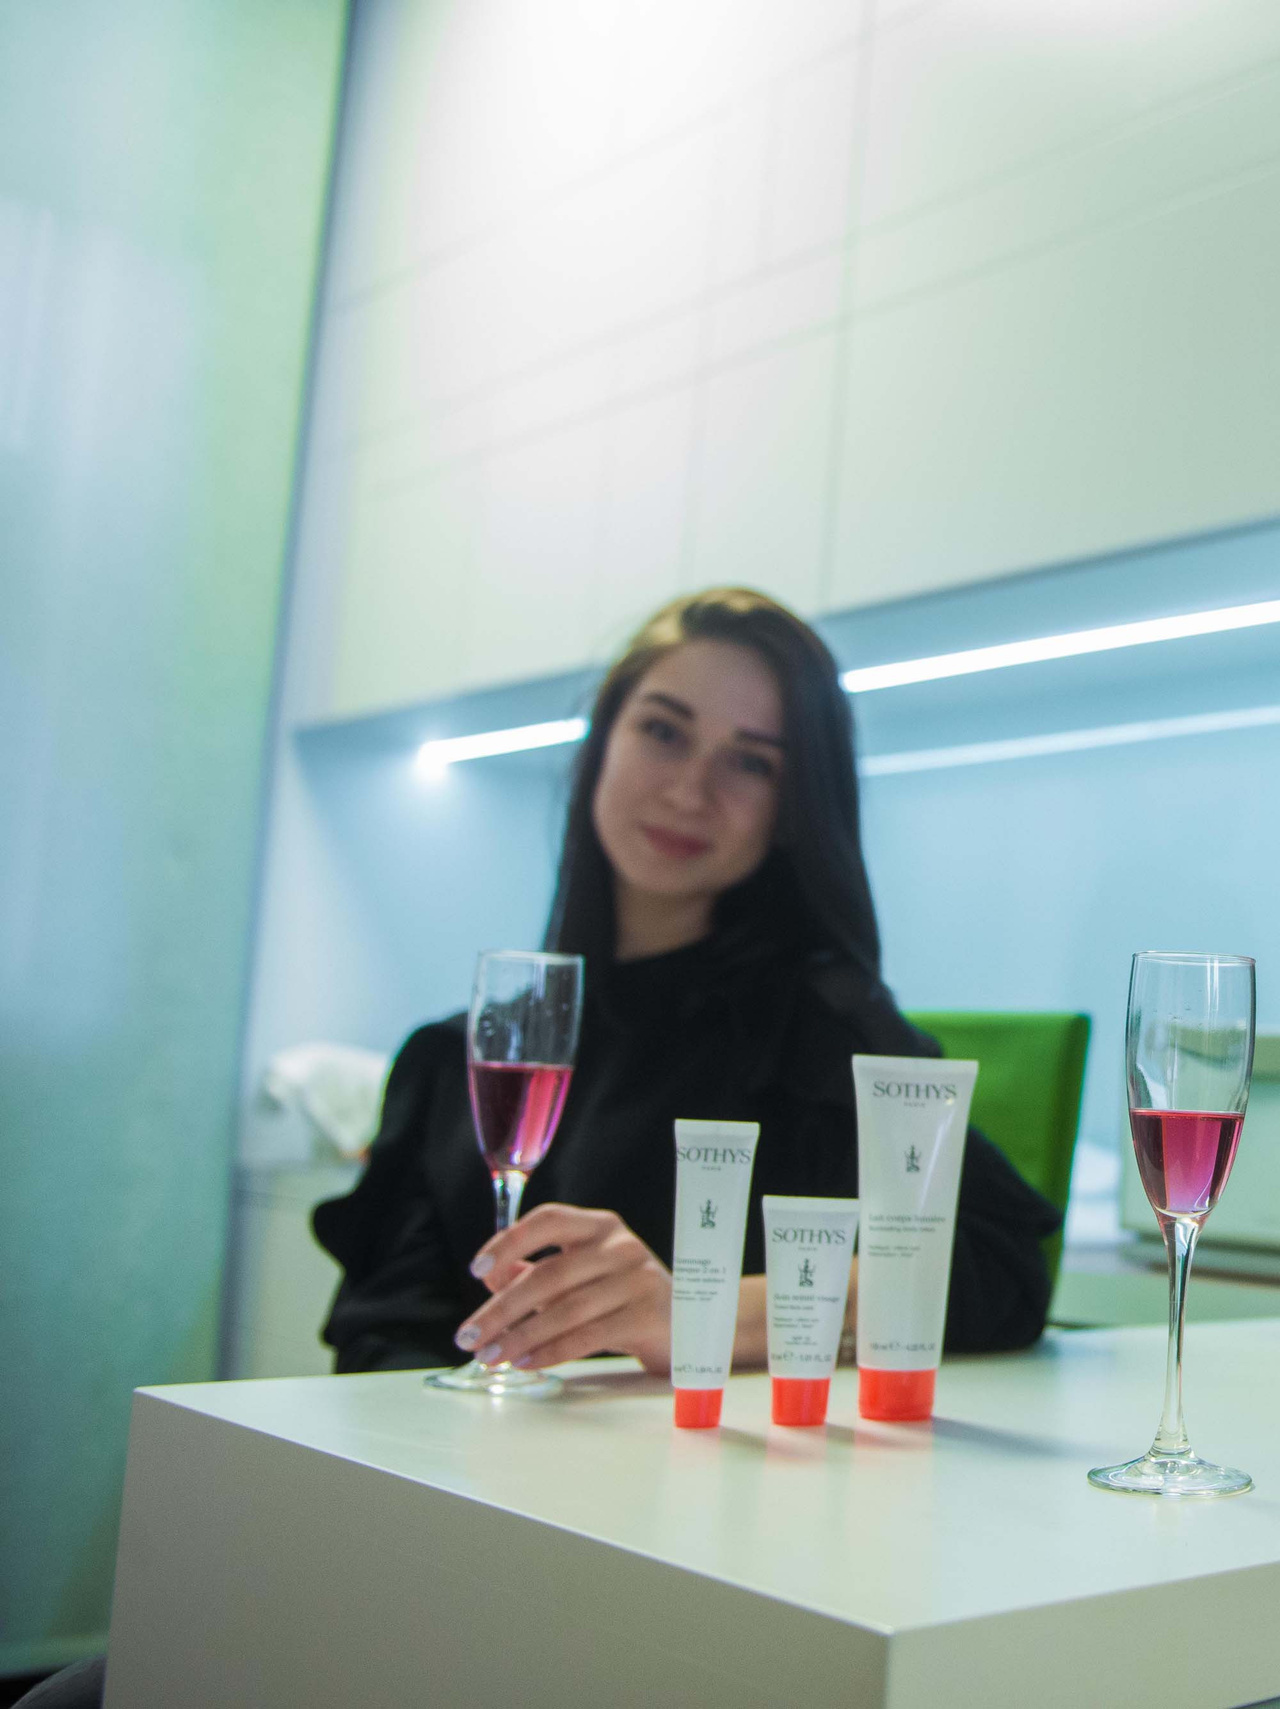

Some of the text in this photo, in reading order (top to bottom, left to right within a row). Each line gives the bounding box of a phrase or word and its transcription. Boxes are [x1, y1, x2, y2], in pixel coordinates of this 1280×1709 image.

[873, 1081, 957, 1100] SOTHYS
[677, 1147, 751, 1164] SOTHYS
[772, 1227, 846, 1245] SOTHYS
